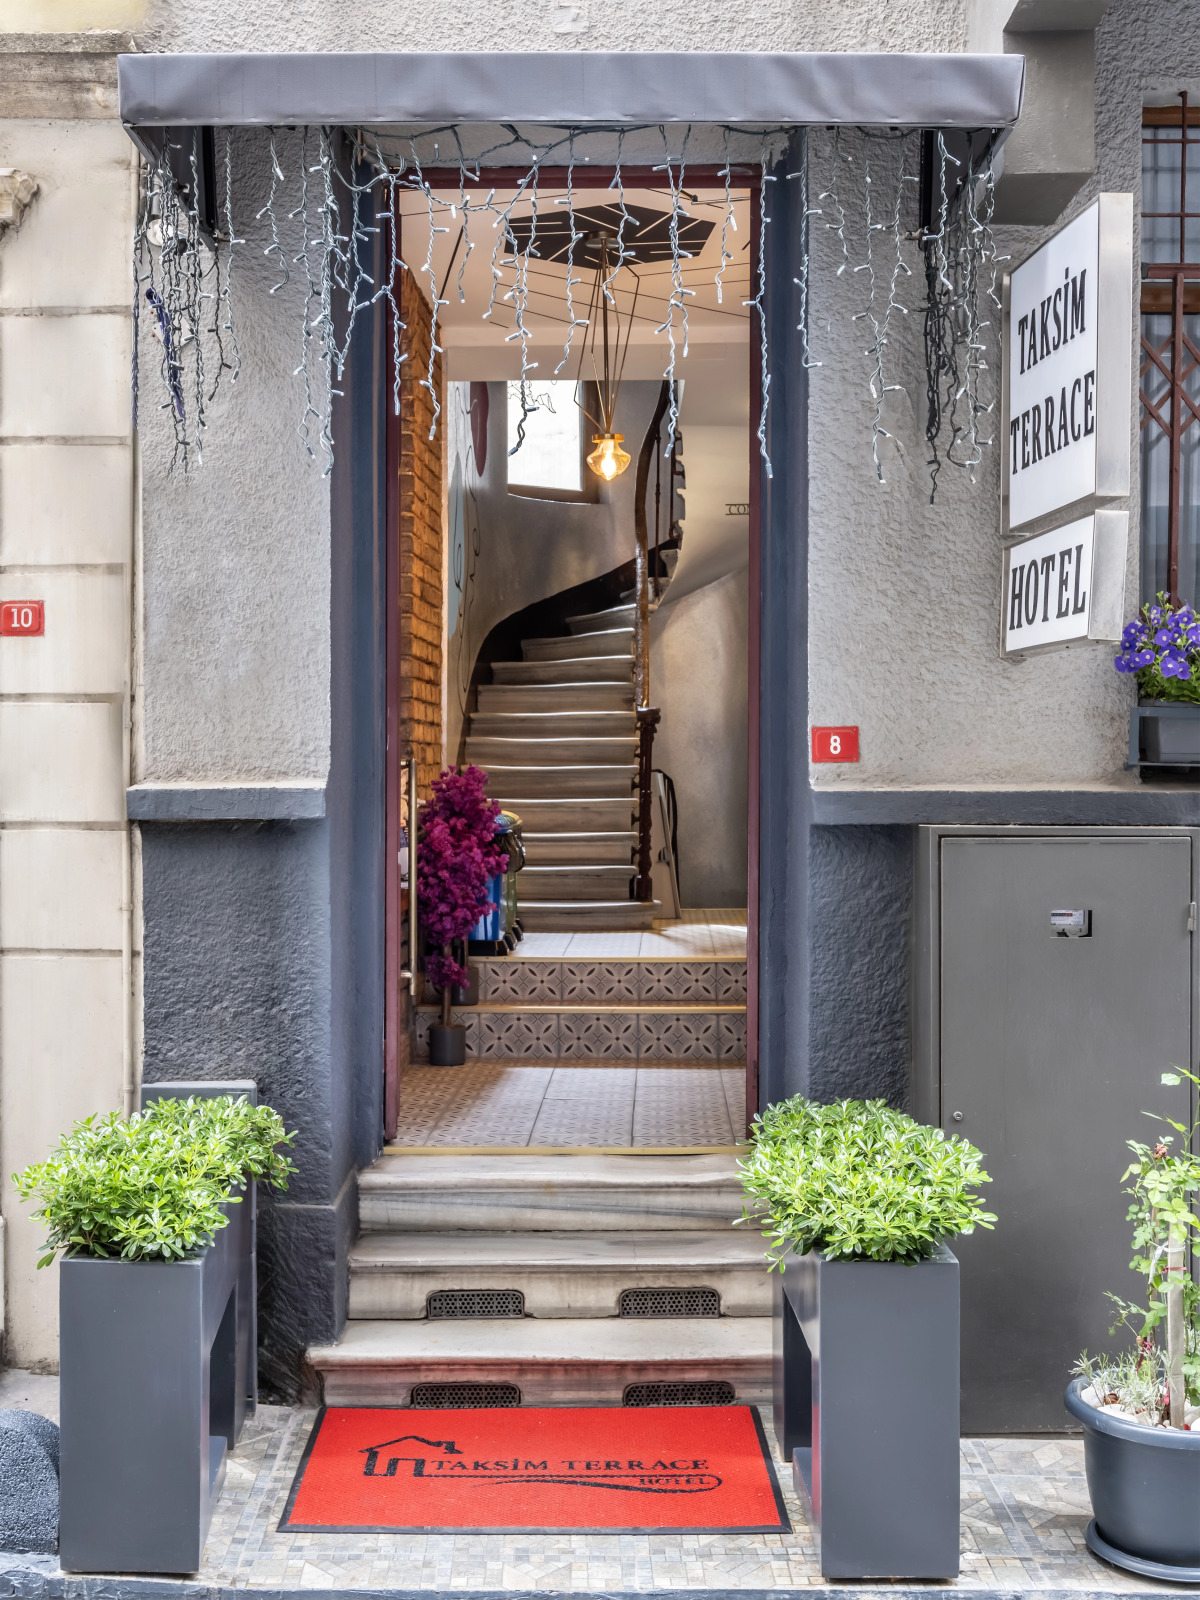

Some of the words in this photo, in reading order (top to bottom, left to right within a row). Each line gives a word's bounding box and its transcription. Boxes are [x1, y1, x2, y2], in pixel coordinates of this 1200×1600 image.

[1018, 267, 1087, 375] TAKSİM
[1010, 370, 1095, 475] TERRACE
[728, 503, 749, 515] CO
[1009, 543, 1086, 631] HOTEL
[11, 608, 32, 628] 10
[830, 735, 841, 755] 8
[431, 1458, 548, 1471] TAKSİM
[561, 1459, 709, 1471] TERRACE
[639, 1477, 710, 1486] HOTEL
